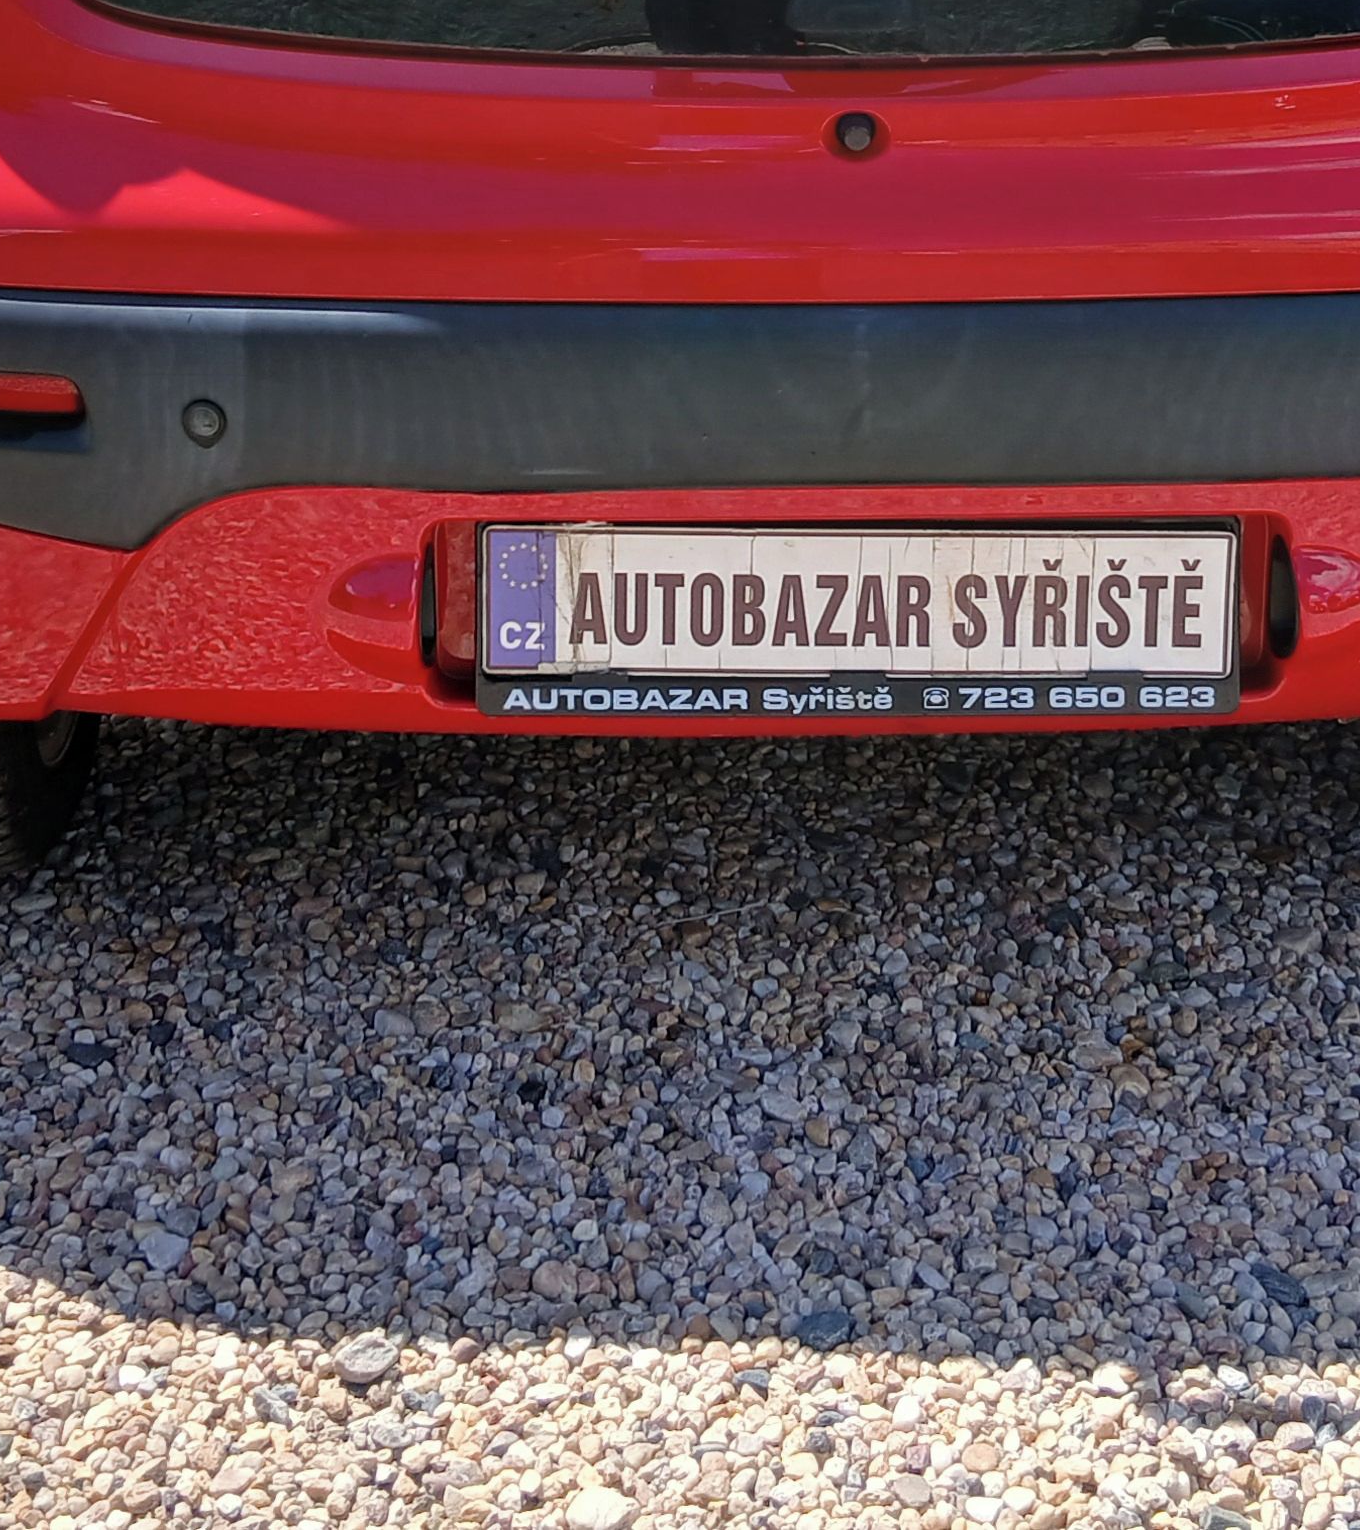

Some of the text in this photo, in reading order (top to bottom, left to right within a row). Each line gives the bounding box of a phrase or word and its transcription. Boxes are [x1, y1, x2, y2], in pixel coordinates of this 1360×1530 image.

[569, 558, 1204, 649] AUTOBAZAR SYŘIŠTĚ
[499, 621, 547, 650] CZ
[502, 686, 1216, 715] AUTOBAZAR Syřiště 723 650 623
